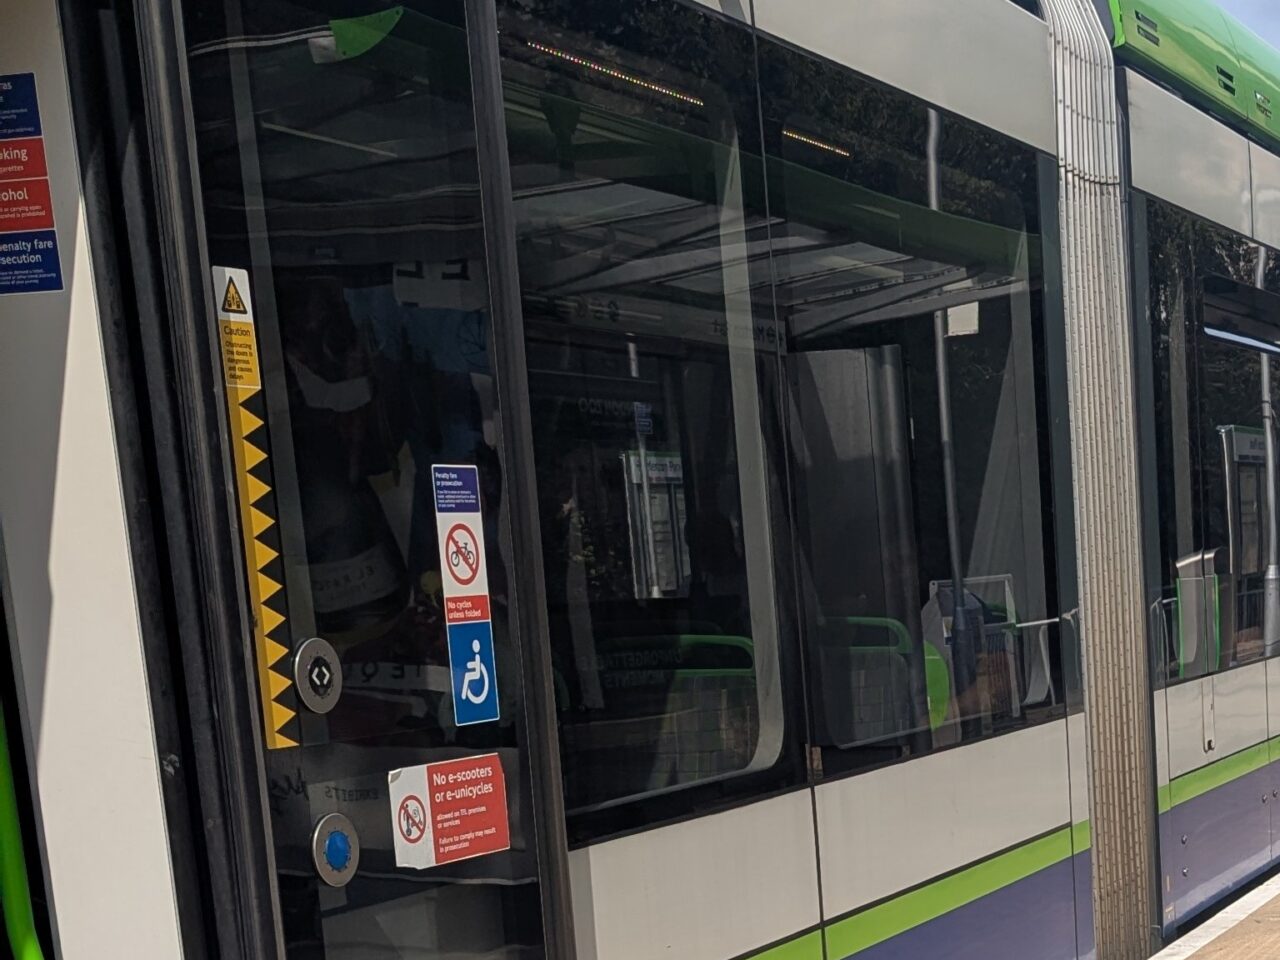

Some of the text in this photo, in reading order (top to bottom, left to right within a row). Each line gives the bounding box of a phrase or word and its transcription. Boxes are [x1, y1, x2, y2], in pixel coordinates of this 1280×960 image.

[0, 147, 28, 161] king
[34, 239, 53, 250] fare
[224, 325, 251, 336] Caution
[447, 600, 472, 610] No cycles
[449, 609, 481, 619] unless folded
[433, 766, 492, 786] No e-scooters
[435, 782, 493, 803] or e-unicycles
[443, 819, 460, 828] services
[439, 836, 453, 845] Failure
[459, 831, 475, 840] comply
[484, 827, 496, 835] result
[444, 841, 470, 853] prosecution
